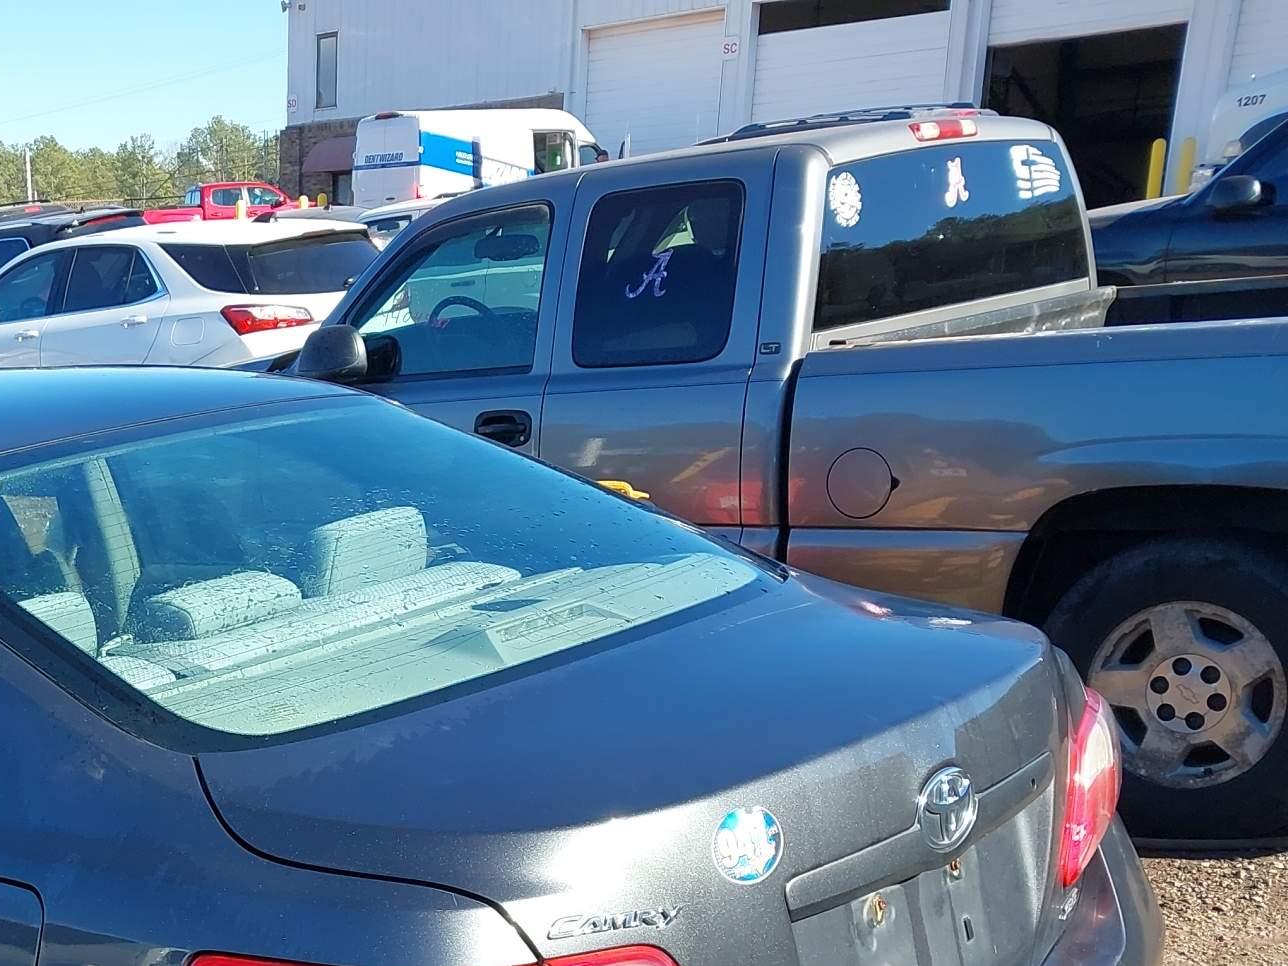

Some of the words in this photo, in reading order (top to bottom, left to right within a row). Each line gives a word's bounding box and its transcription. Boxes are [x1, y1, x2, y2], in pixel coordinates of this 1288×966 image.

[723, 42, 737, 54] SC
[1237, 94, 1267, 107] 1207
[625, 248, 674, 298] A
[760, 344, 780, 353] LT
[547, 903, 690, 940] CAMRY
